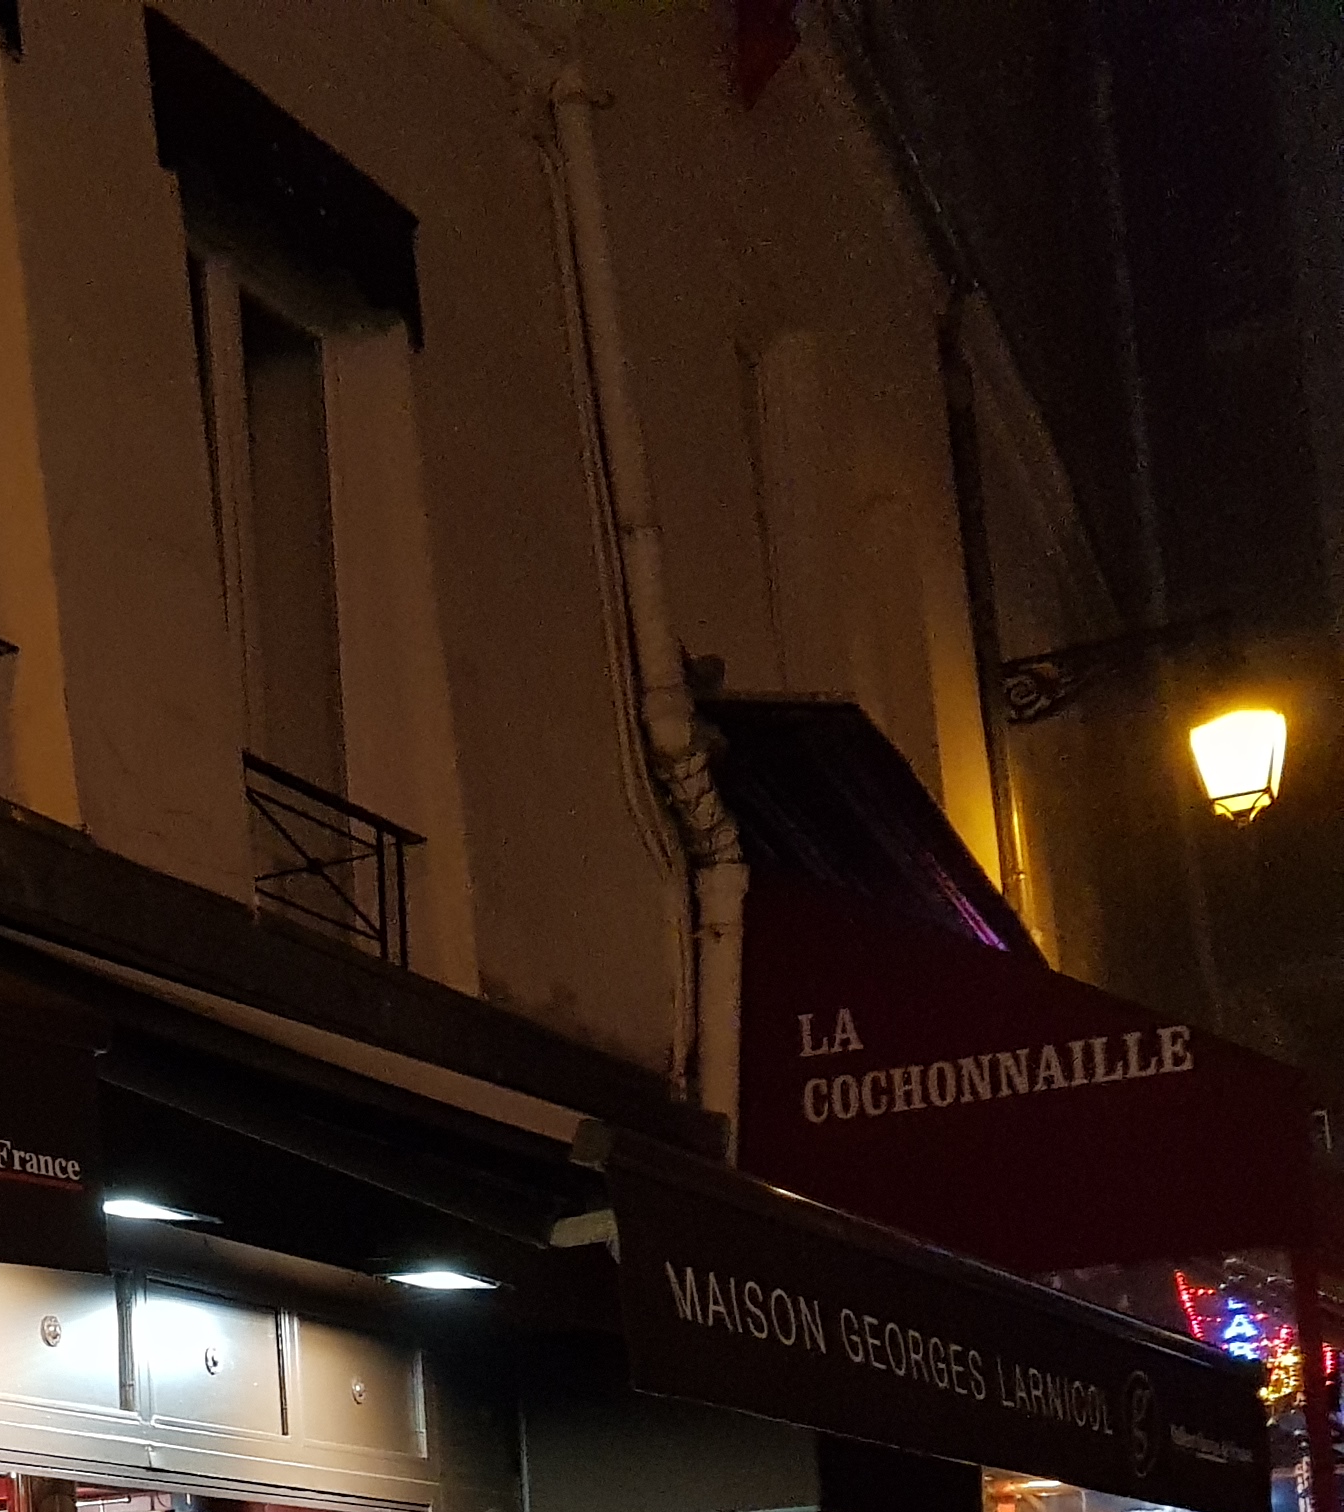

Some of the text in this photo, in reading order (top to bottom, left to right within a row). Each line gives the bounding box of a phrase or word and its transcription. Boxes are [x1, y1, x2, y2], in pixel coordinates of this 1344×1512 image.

[798, 1008, 864, 1057] LA
[803, 1025, 1194, 1123] COCHONNAILLE
[665, 1261, 1113, 1435] MAISON GEORGES LARNICOL
